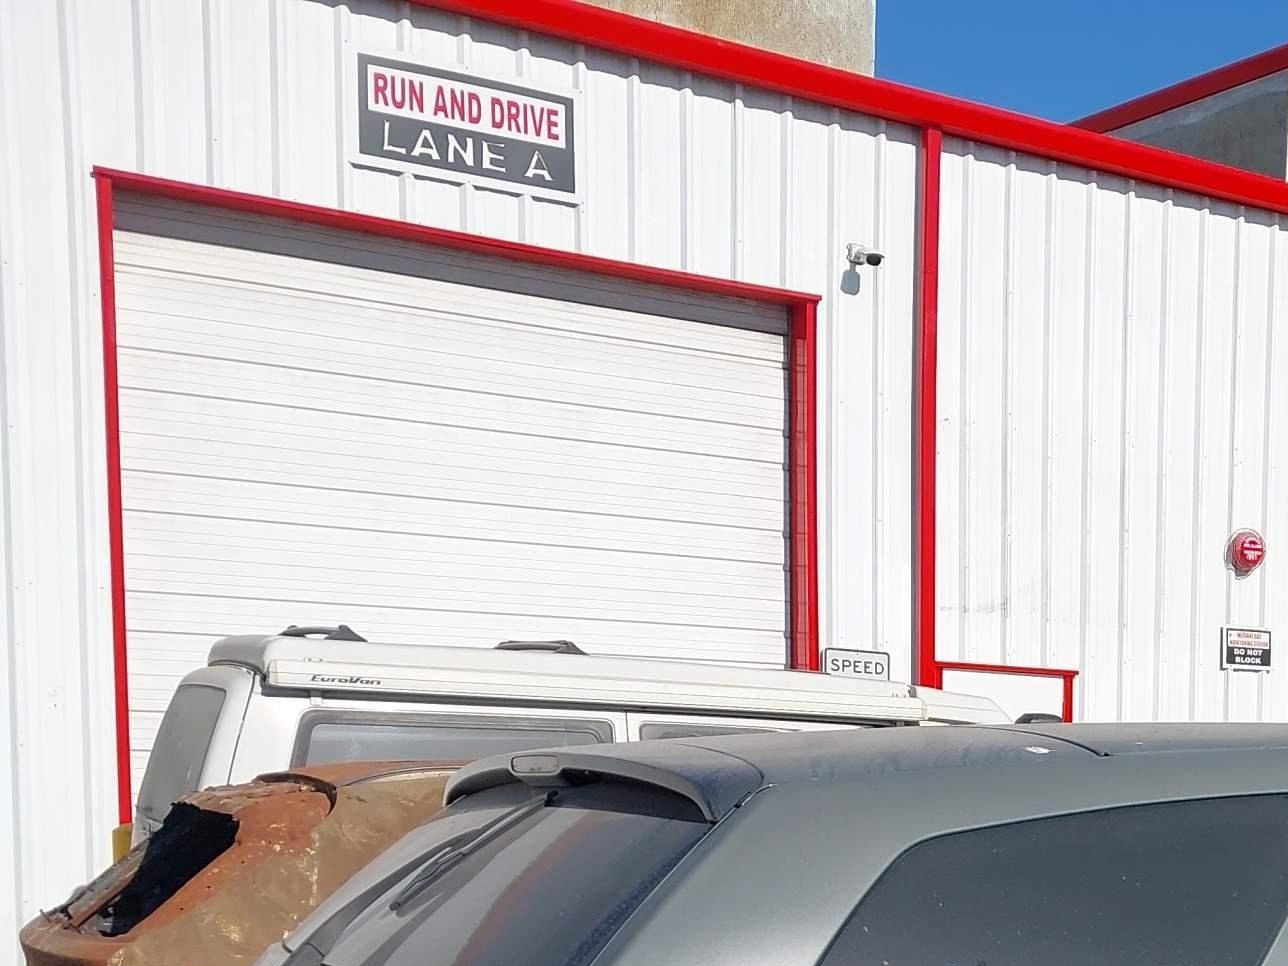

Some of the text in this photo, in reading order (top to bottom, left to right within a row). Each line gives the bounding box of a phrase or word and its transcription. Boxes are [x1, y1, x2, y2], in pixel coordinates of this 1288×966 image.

[373, 71, 560, 141] RUN AND DRIVE
[382, 119, 553, 181] LANE A
[1233, 648, 1245, 656] DO
[830, 658, 885, 675] SPEED
[1235, 656, 1262, 664] BLOCK
[310, 674, 381, 686] EuroVan
